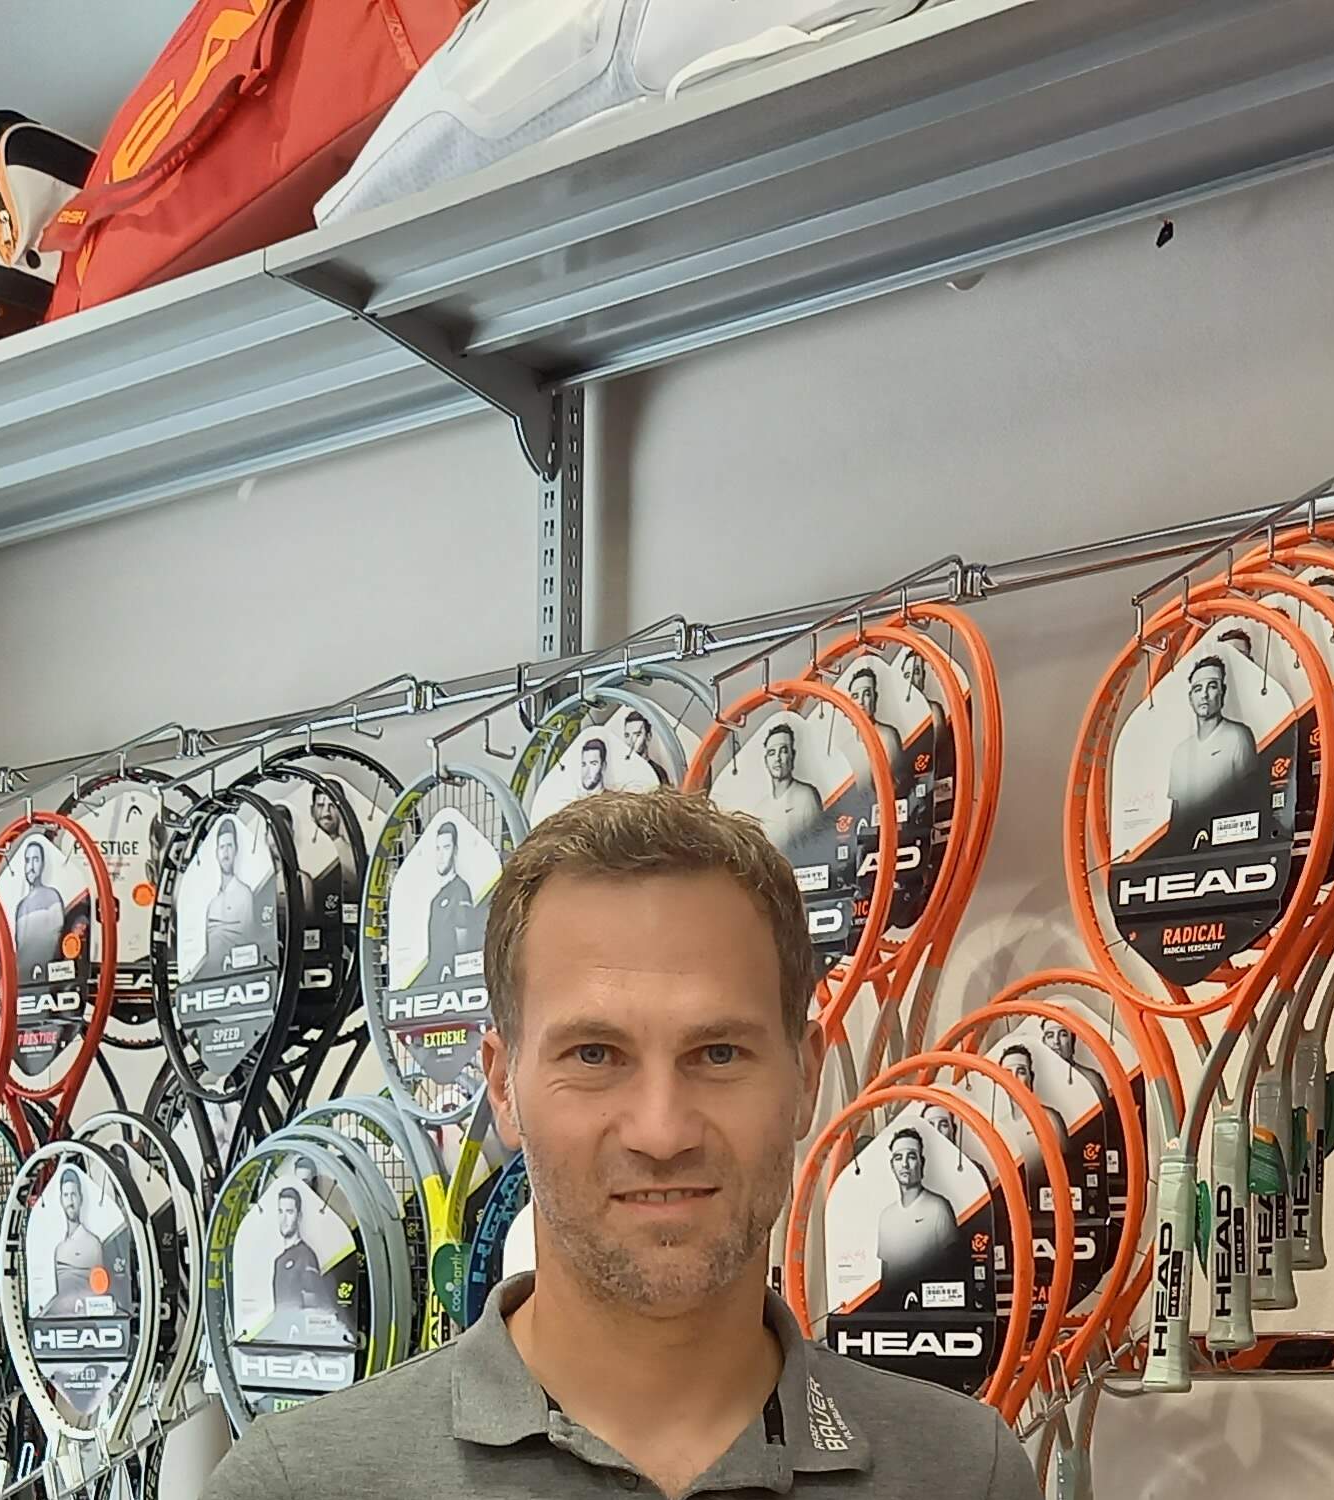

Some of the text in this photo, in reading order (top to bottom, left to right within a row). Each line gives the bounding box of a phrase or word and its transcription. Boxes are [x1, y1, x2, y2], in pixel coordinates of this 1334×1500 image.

[1118, 862, 1278, 906] HEAD
[1162, 922, 1226, 946] RADICAL
[180, 981, 270, 1014] HEAD
[387, 988, 490, 1021] HEAD
[212, 1027, 241, 1044] SPEED
[422, 1027, 468, 1048] EXTREME
[1215, 1184, 1233, 1318] HEAD
[1153, 1222, 1173, 1357] HEAD
[33, 1323, 124, 1353] HEAD
[837, 1330, 984, 1359] HEAD
[69, 1366, 98, 1382] SPEED
[240, 1354, 346, 1383] HEAD
[815, 1375, 850, 1452] BAUER
